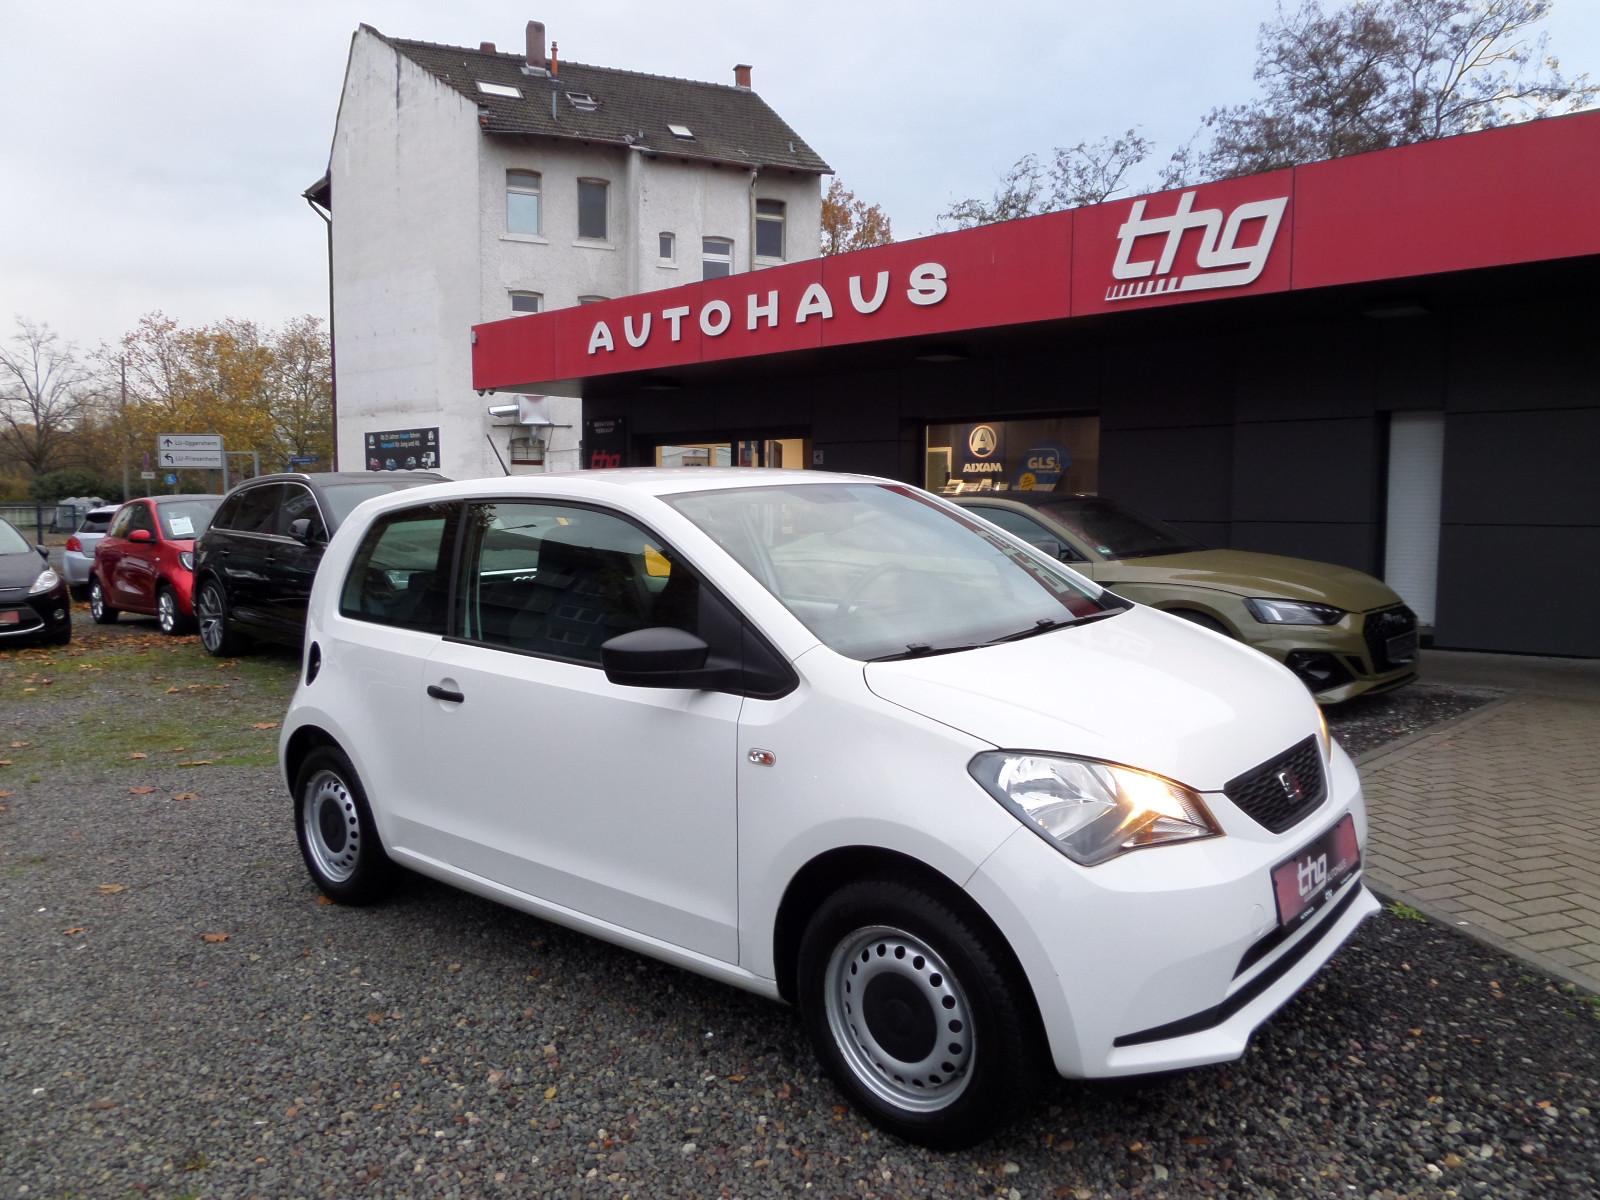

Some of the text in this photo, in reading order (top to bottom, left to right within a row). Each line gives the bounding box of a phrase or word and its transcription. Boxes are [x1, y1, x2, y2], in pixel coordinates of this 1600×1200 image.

[1105, 191, 1289, 301] thg
[588, 262, 948, 354] AUTOHAUS
[962, 462, 1003, 473] AIXAM
[1027, 456, 1056, 469] GLS
[1296, 853, 1327, 902] thg
